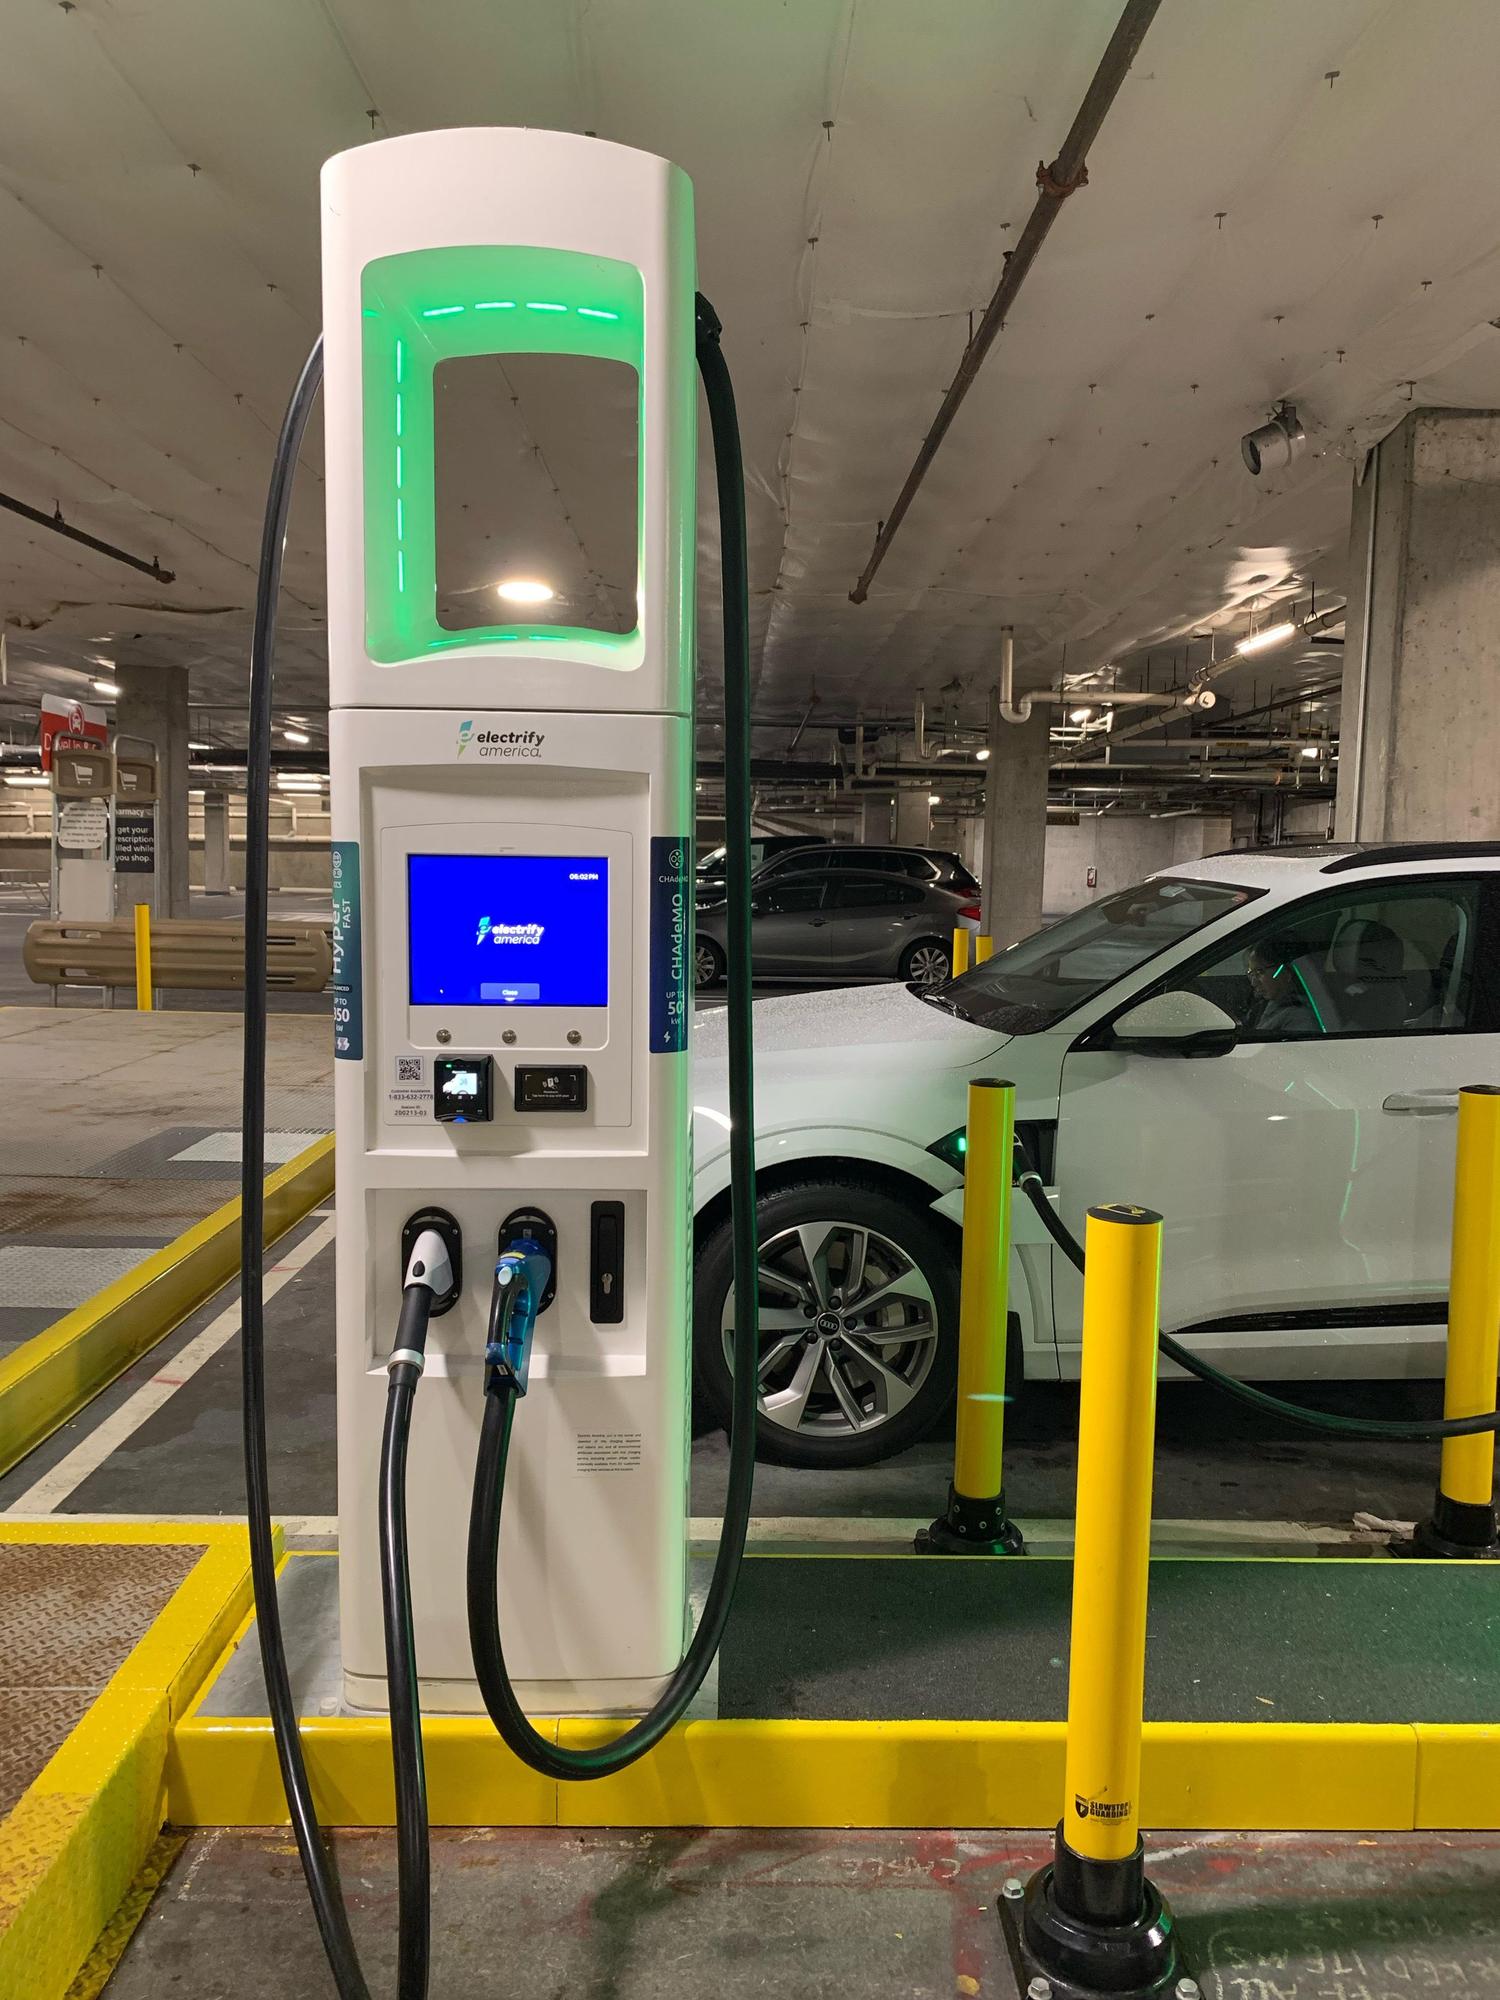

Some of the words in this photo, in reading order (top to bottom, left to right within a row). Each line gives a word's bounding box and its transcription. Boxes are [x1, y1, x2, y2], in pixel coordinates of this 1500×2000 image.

[477, 731, 545, 747] electrify
[117, 826, 130, 834] get
[342, 898, 351, 929] FAST
[491, 924, 544, 936] electrify
[671, 893, 683, 980] CHAdeMO
[665, 991, 676, 999] UP
[667, 1001, 683, 1015] 50
